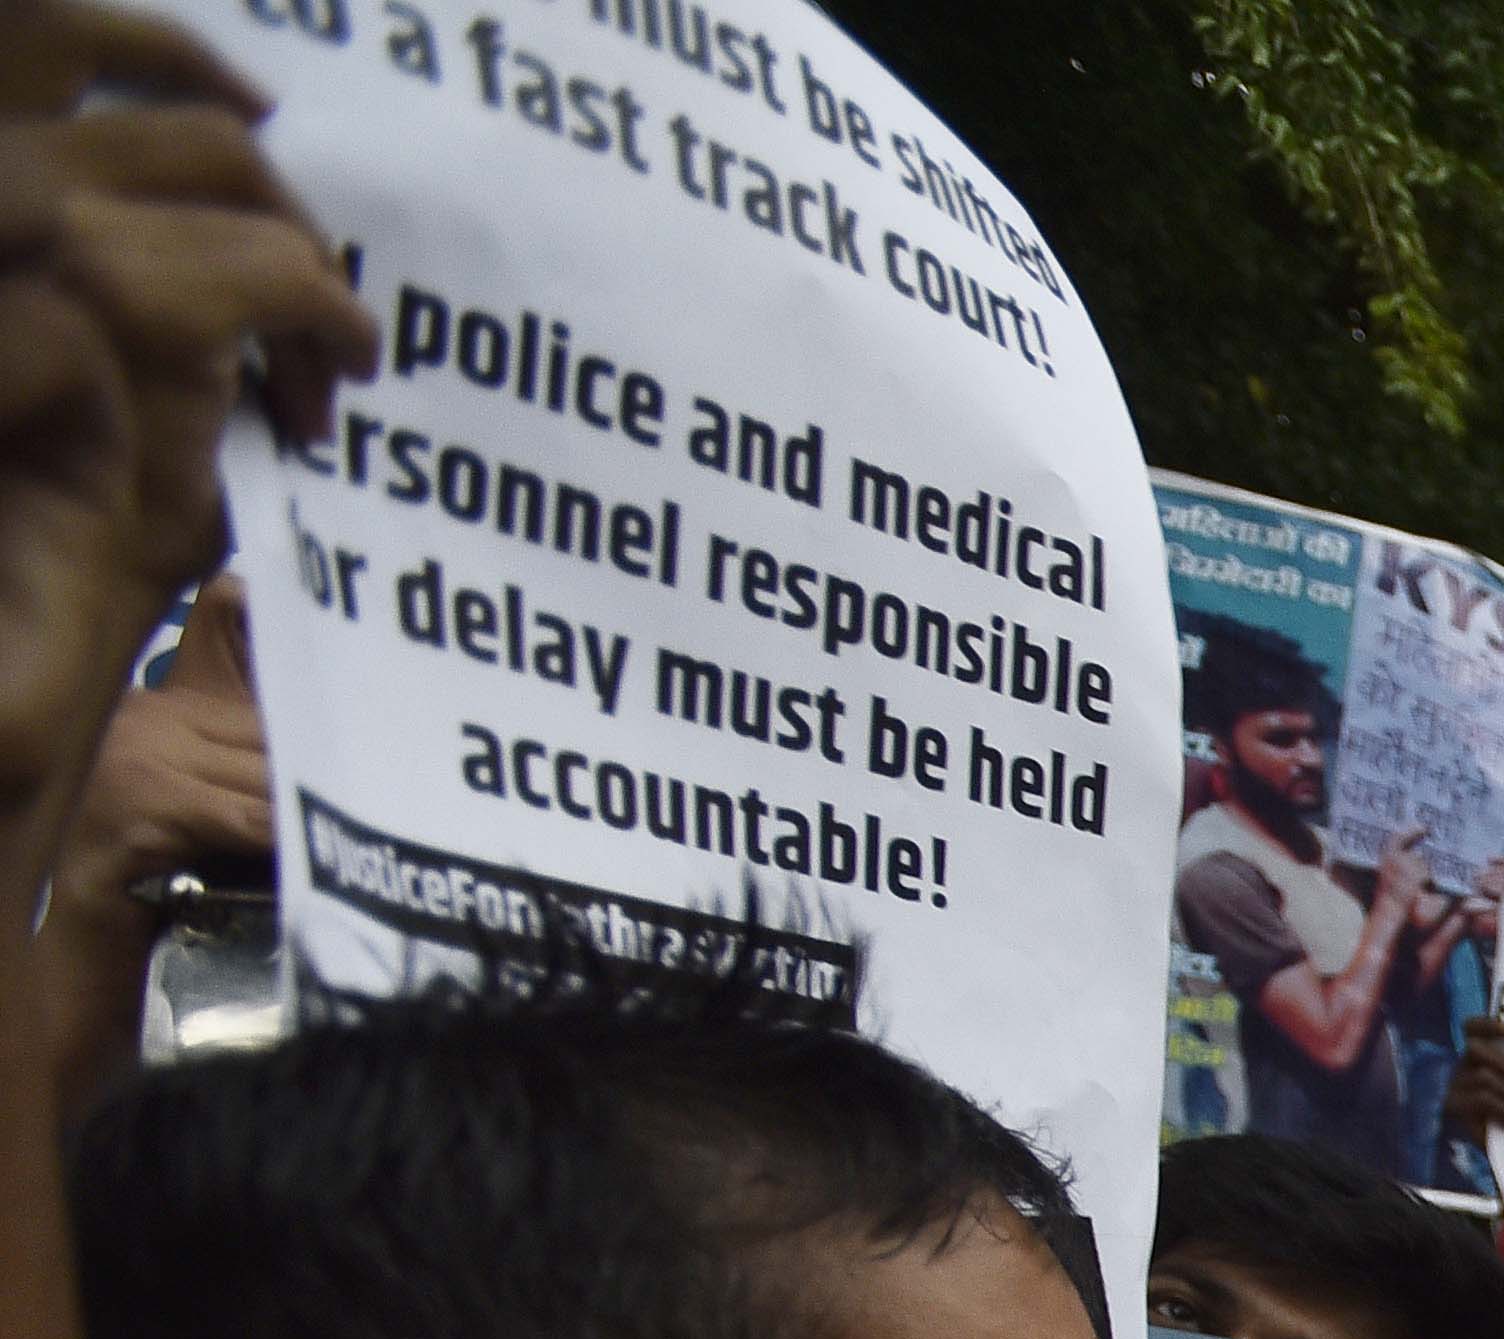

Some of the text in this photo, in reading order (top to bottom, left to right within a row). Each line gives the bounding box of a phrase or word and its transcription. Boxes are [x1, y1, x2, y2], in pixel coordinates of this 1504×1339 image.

[385, 0, 1056, 379] a fast track court!
[799, 50, 1070, 306] be shifted
[394, 282, 667, 449] police
[687, 396, 825, 508] and
[850, 456, 1107, 613] medical
[394, 557, 1110, 838] delay must be held
[706, 532, 1114, 726] responsible
[459, 721, 949, 911] accountable!
